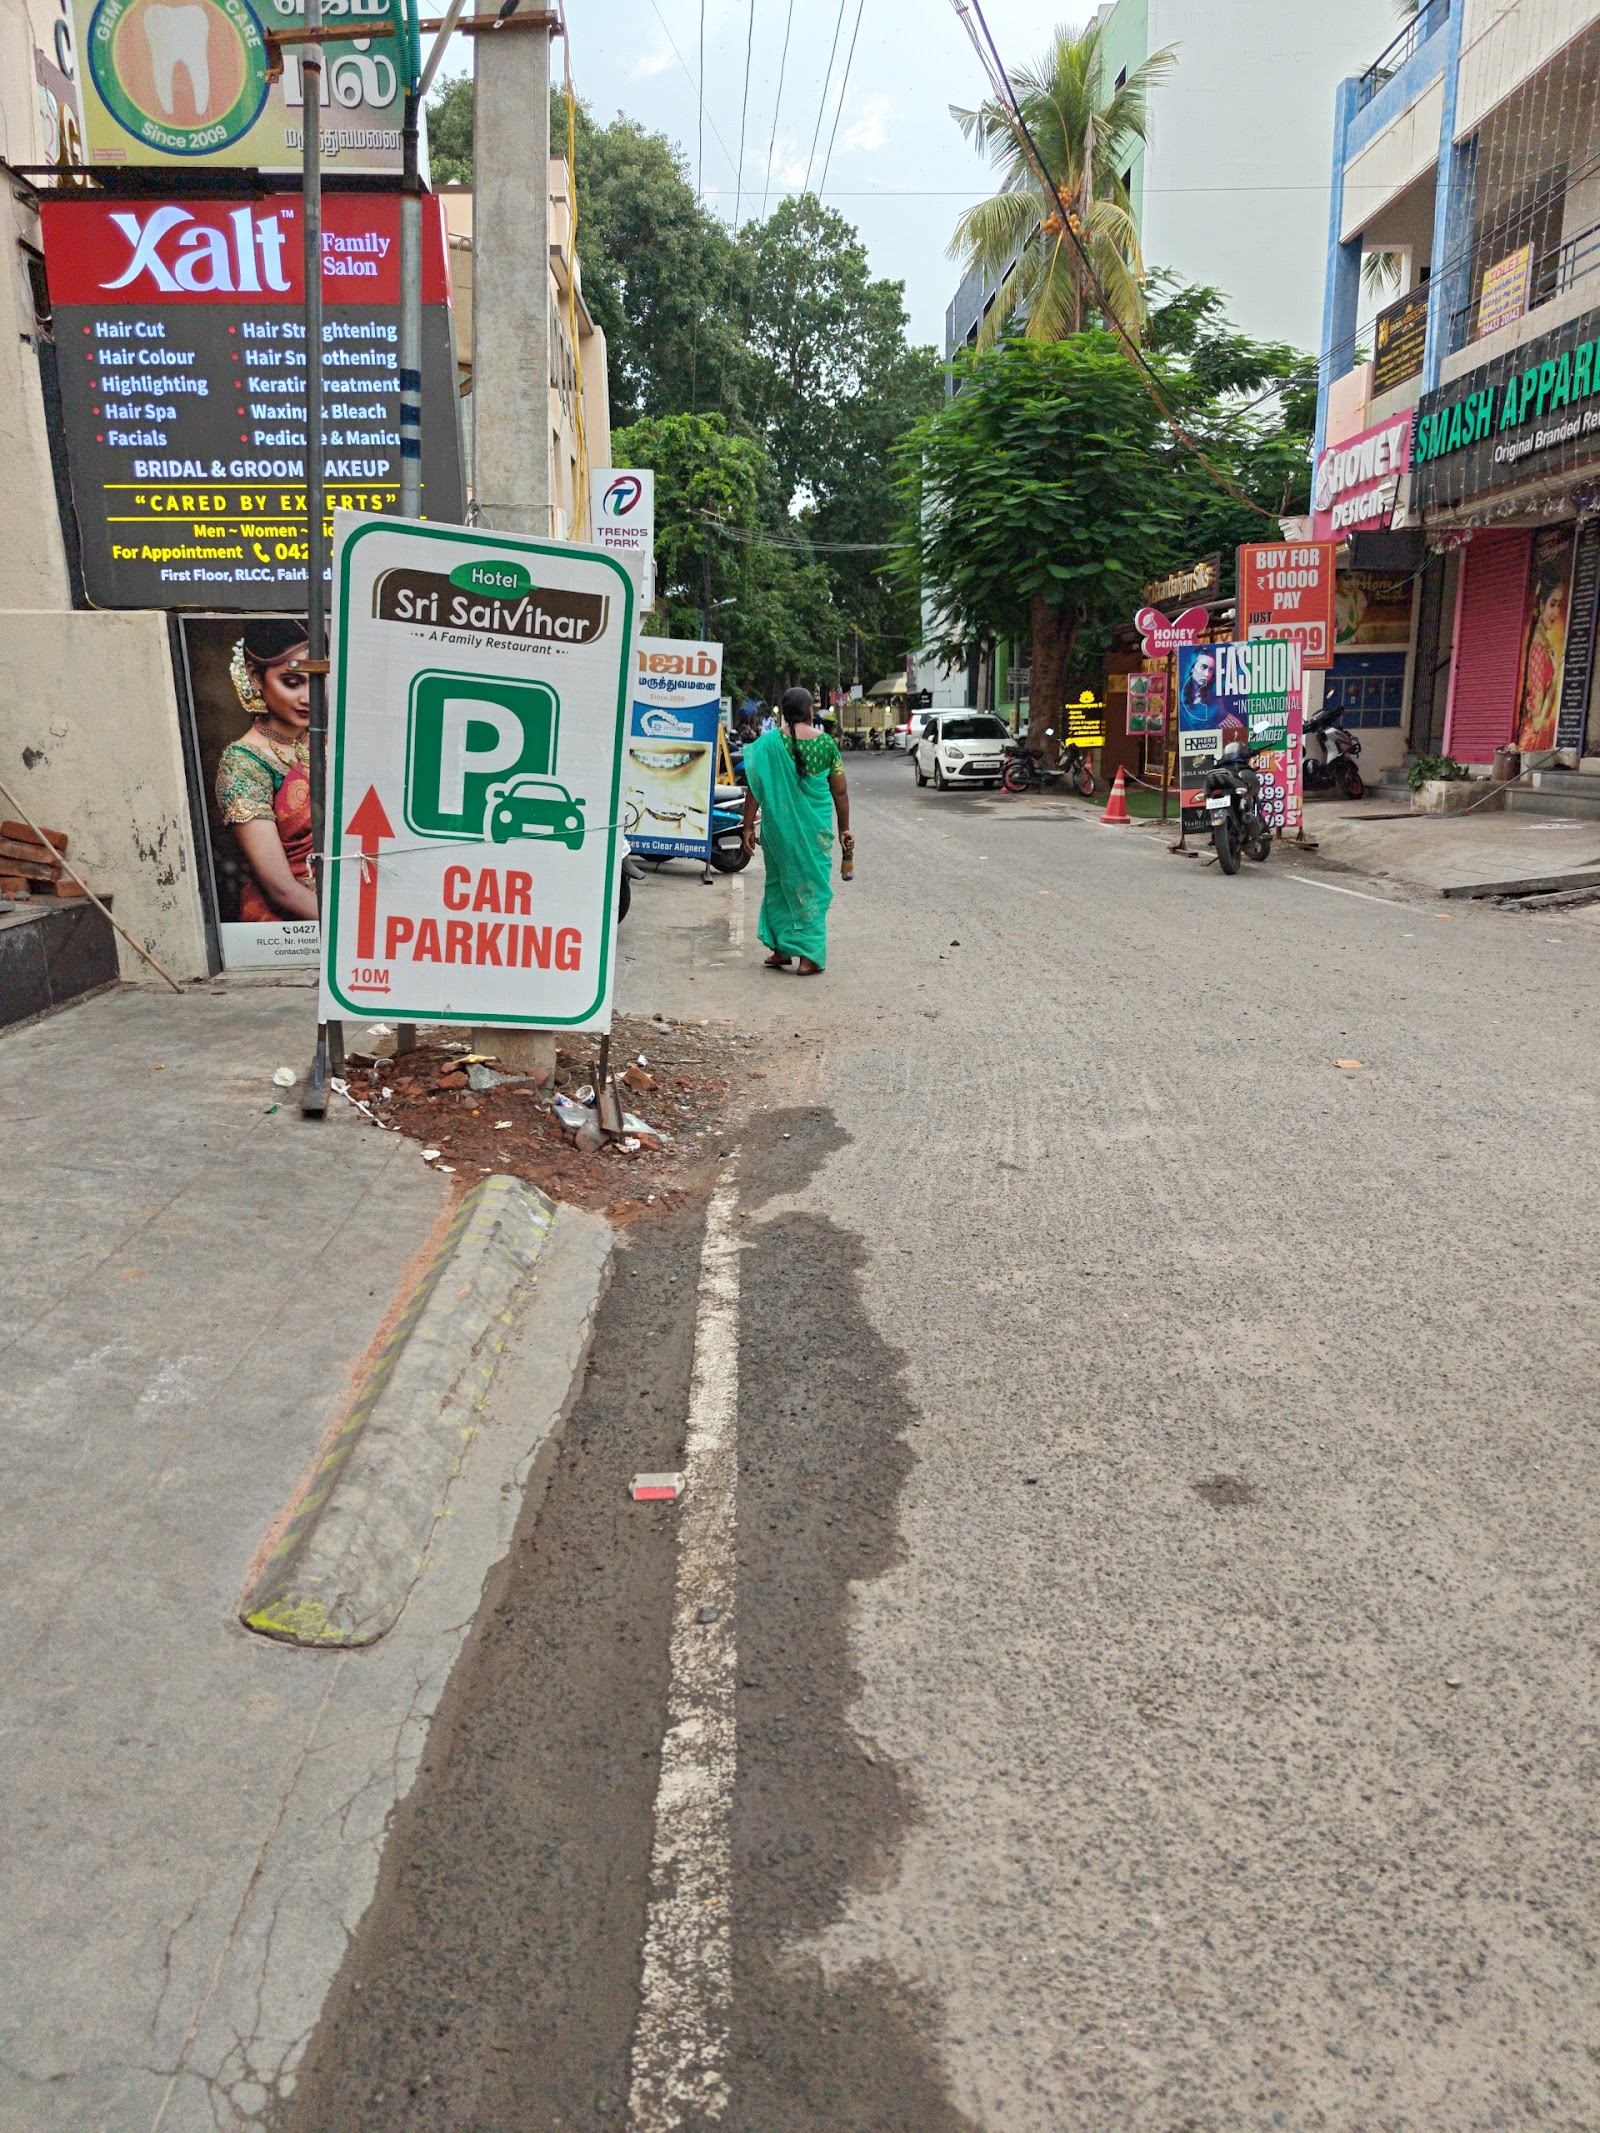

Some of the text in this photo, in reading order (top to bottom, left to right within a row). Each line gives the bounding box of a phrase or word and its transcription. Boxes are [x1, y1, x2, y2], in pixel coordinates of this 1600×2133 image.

[97, 2, 123, 41] GEM
[226, 0, 261, 48] CARE
[142, 121, 228, 148] Since 2009
[99, 206, 291, 292] Xalt
[322, 233, 390, 258] Family
[323, 256, 379, 276] Salon
[96, 321, 166, 338] Hair Cut
[243, 321, 398, 342] Hair Strghtening
[99, 348, 195, 365] Hair Colour
[246, 348, 398, 369] Hair Smothening
[102, 375, 209, 396] Highlighting
[321, 377, 401, 392] reatment
[105, 403, 177, 423] Hair Spa
[332, 403, 387, 419] Bleach
[1416, 386, 1495, 464] SMASH
[109, 430, 168, 446] Facials
[255, 430, 328, 446] Pedicue
[331, 430, 343, 446] &
[1495, 434, 1534, 463] Original
[1535, 417, 1581, 449] Branded
[1329, 421, 1409, 495] HONEY
[134, 460, 390, 478] BRIDAL & GROOM AKEUP
[240, 495, 267, 511] BY
[193, 524, 226, 538] Men
[240, 524, 298, 538] Women
[597, 528, 648, 536] TRENDS
[605, 539, 639, 547] PARK
[112, 545, 139, 559] For
[141, 544, 244, 562] Appointment
[1256, 548, 1320, 569] BUY FOR
[160, 569, 191, 581] First
[193, 568, 233, 582] Floor,
[235, 568, 275, 582] RLCC,
[471, 568, 518, 589] Hotel
[394, 589, 438, 622] Sri
[1273, 591, 1301, 610] PAY
[1249, 612, 1272, 624] JUST
[428, 631, 553, 655] A Family Restaurant
[1154, 628, 1195, 640] HONEY
[1215, 642, 1302, 696] FASHION
[638, 676, 717, 692] மருத்துவமனை
[1249, 712, 1289, 728] LUXURY
[437, 698, 525, 816] P
[652, 841, 673, 850] Clear
[674, 843, 706, 854] Aligners
[442, 865, 534, 916] CAR
[293, 925, 316, 934] 0427
[256, 937, 319, 946] RLCC, Nr. Hotel
[384, 915, 583, 972] PARKING
[351, 967, 390, 984] 10M
